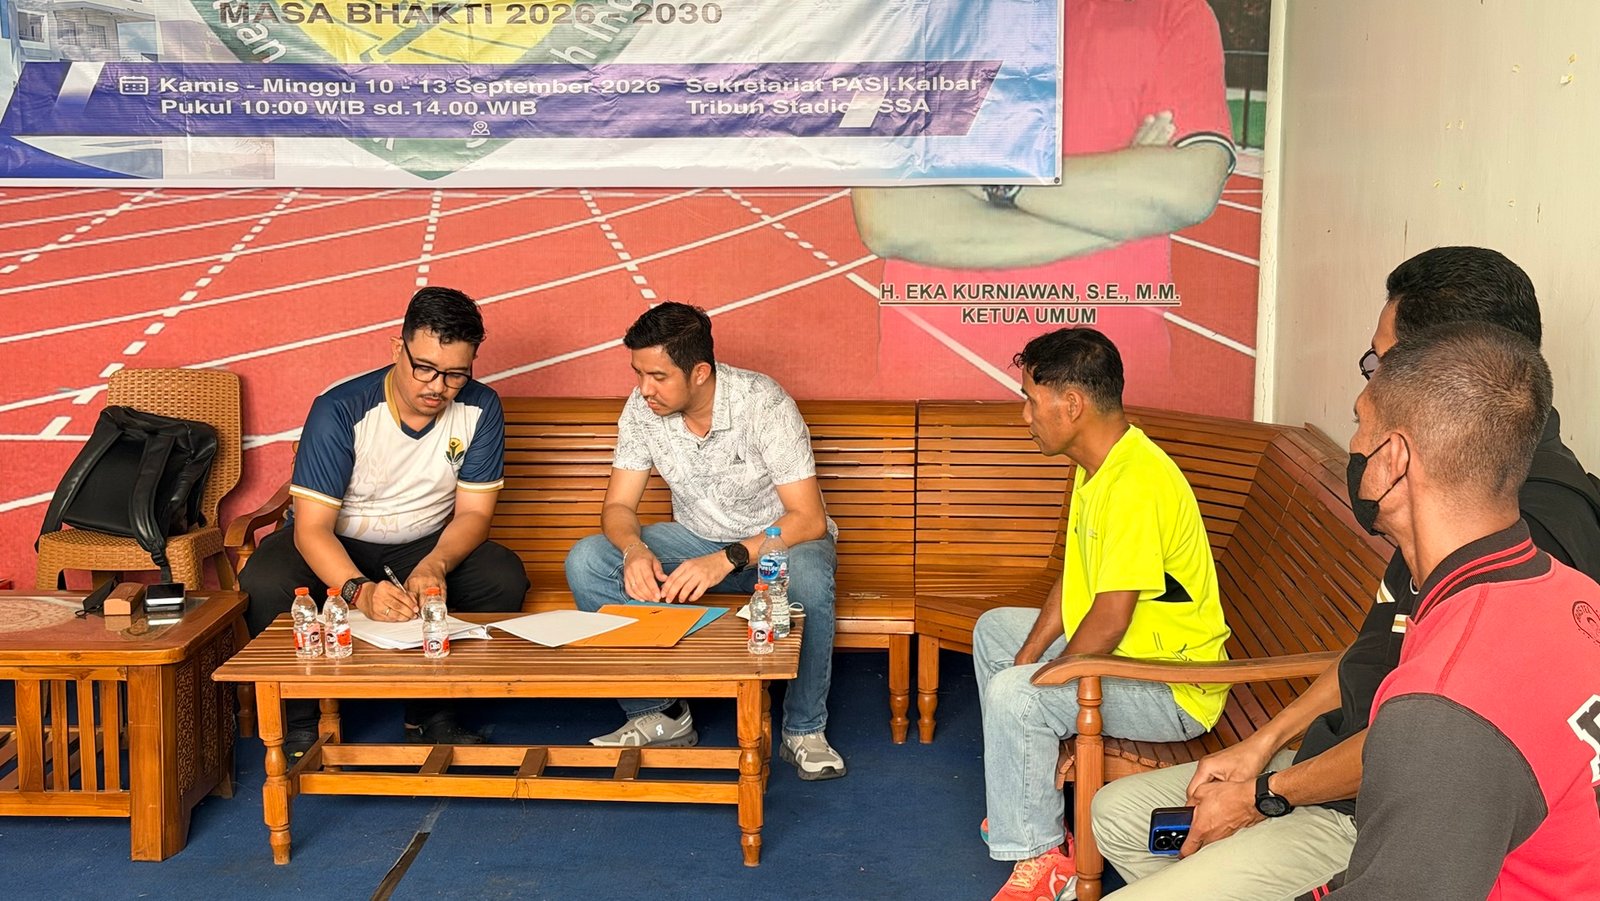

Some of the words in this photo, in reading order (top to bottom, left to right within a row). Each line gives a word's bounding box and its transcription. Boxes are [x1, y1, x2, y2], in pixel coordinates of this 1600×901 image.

[219, 2, 336, 25] MASA
[346, 2, 493, 25] BHAKTI
[506, 3, 596, 25] 2026
[632, 3, 724, 25] 2030
[160, 77, 239, 93] Kamis
[263, 78, 356, 97] Minggu
[365, 79, 394, 94] 10
[419, 79, 447, 94] 13
[455, 78, 593, 97] September
[600, 79, 660, 94] 2026
[686, 78, 824, 93] Sekretariat
[161, 99, 232, 115] Pukul
[240, 99, 308, 115] 10:00
[314, 100, 365, 115] WIB
[686, 99, 764, 115] Tribun
[773, 98, 852, 115] Stadio
[877, 97, 931, 114] SSA
[880, 283, 900, 300] H.
[906, 283, 948, 300] EKA
[953, 283, 1080, 303] KURNIAWAN,
[1086, 283, 1130, 303] S.E.,
[1136, 283, 1180, 300] M.M.
[962, 307, 1030, 324] KETUA
[1035, 307, 1096, 324] UMUM
